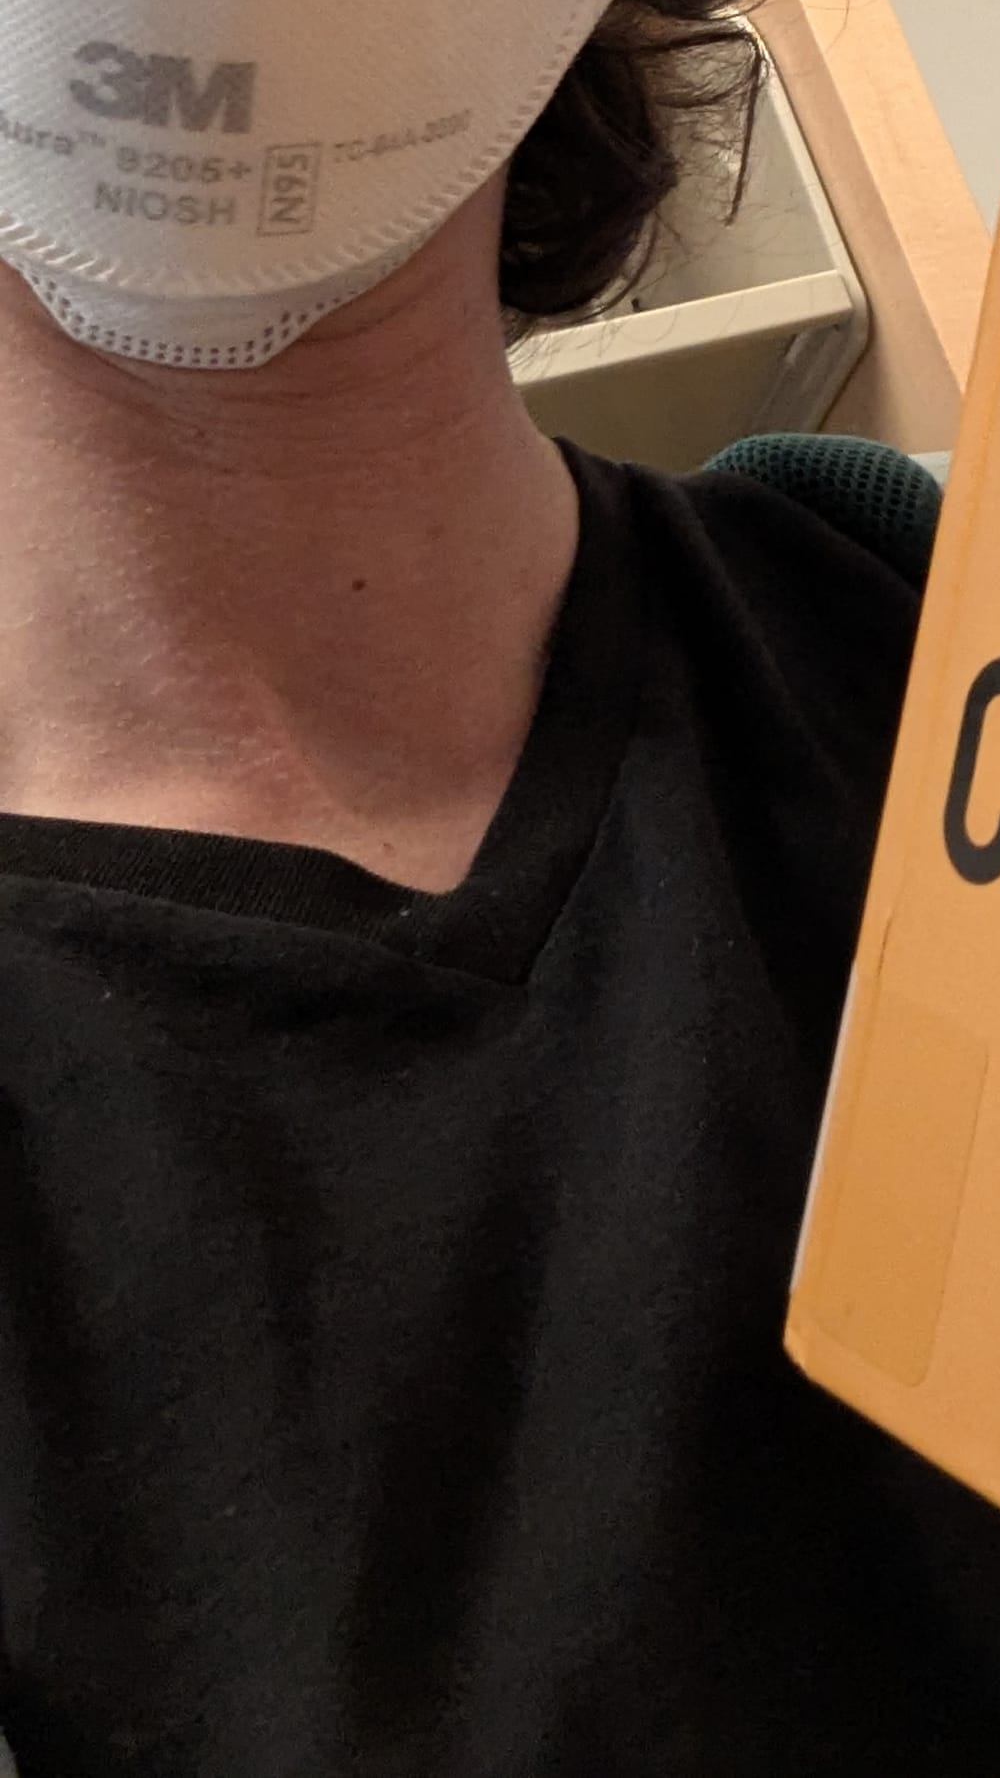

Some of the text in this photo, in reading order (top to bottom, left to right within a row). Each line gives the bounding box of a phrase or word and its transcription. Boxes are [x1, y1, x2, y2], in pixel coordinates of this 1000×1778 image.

[69, 40, 256, 134] 3M
[94, 180, 237, 226] NIOSH
[268, 152, 309, 224] N95
